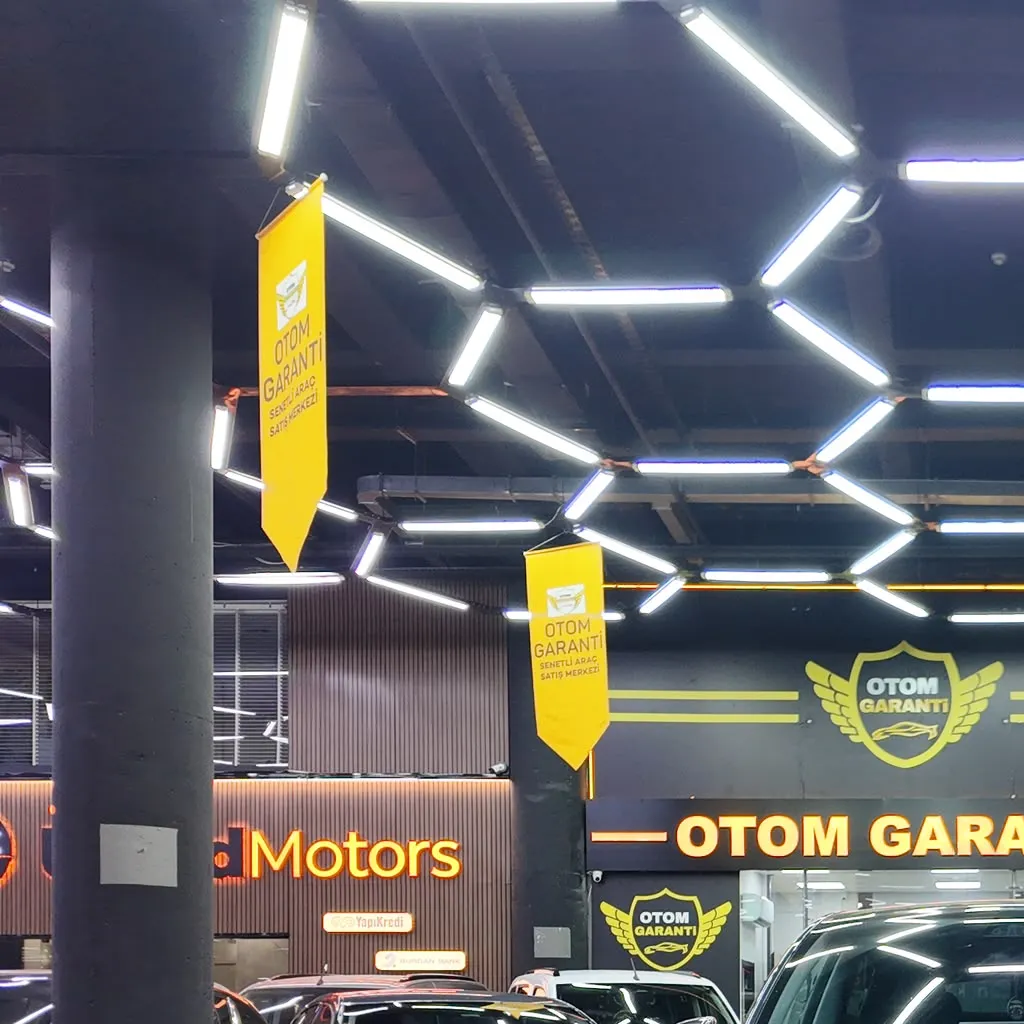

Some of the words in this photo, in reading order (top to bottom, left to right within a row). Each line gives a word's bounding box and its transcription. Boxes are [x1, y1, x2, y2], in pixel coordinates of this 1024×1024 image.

[274, 314, 310, 365] OTOM
[263, 332, 323, 402] GARANTİ
[545, 618, 591, 638] OTOM
[534, 630, 603, 658] GARANTİ
[866, 677, 939, 696] OTOM
[676, 815, 850, 858] OTOM
[639, 911, 690, 924] OTOM
